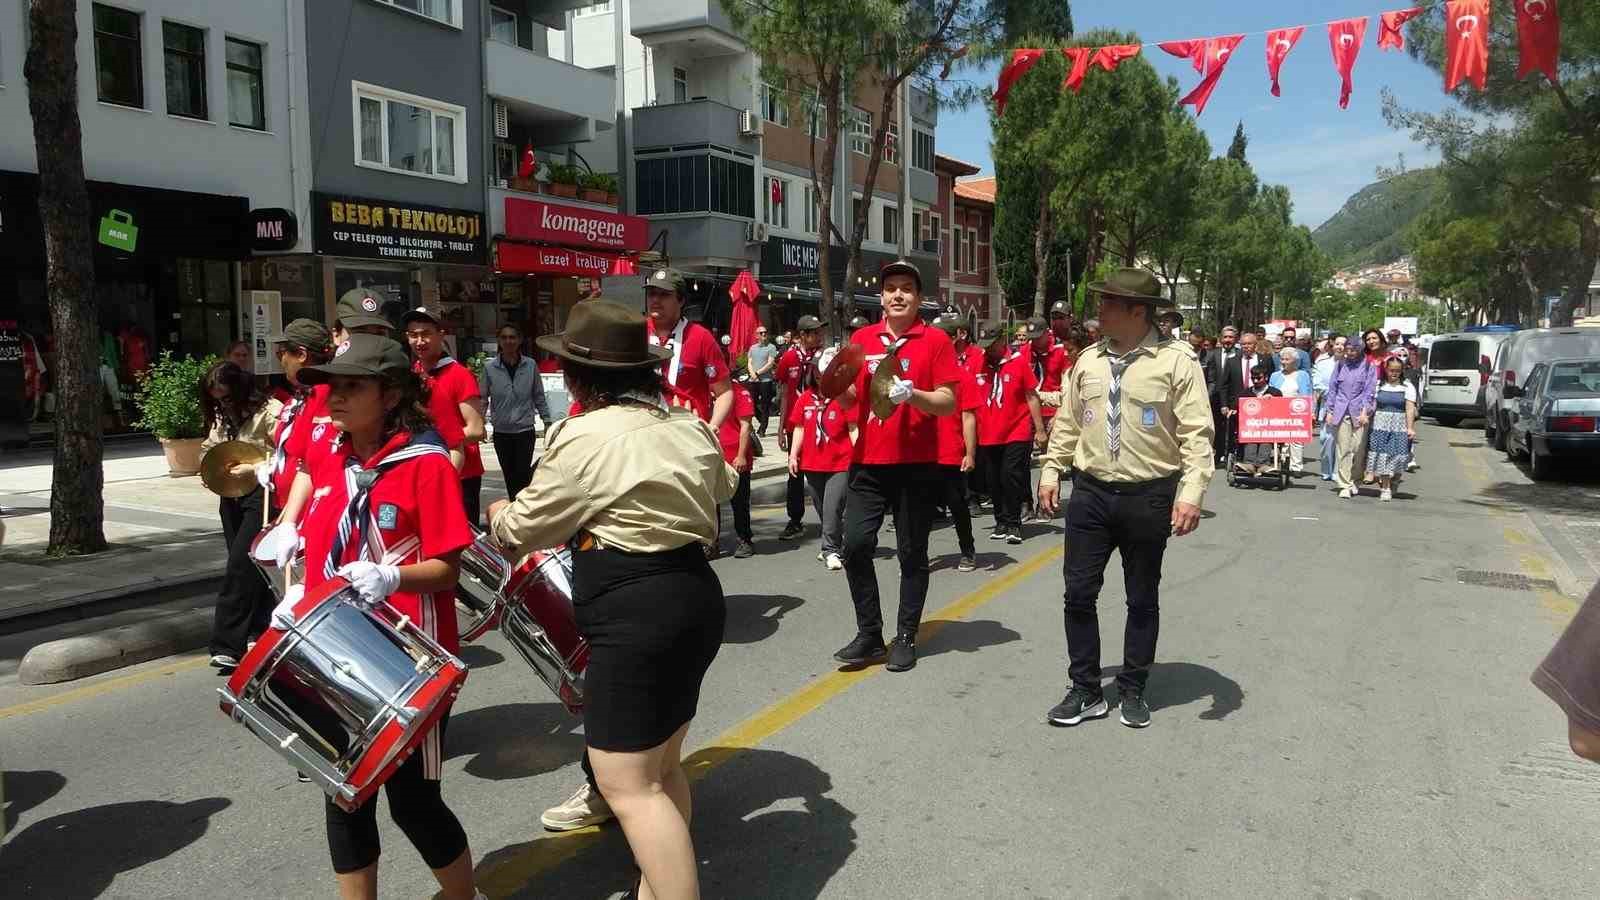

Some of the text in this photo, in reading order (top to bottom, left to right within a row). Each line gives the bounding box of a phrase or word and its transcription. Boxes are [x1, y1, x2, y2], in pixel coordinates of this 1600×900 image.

[331, 201, 384, 227] BEBA
[541, 205, 625, 241] komagene
[333, 231, 349, 241] CEP
[782, 239, 801, 267] İNCE
